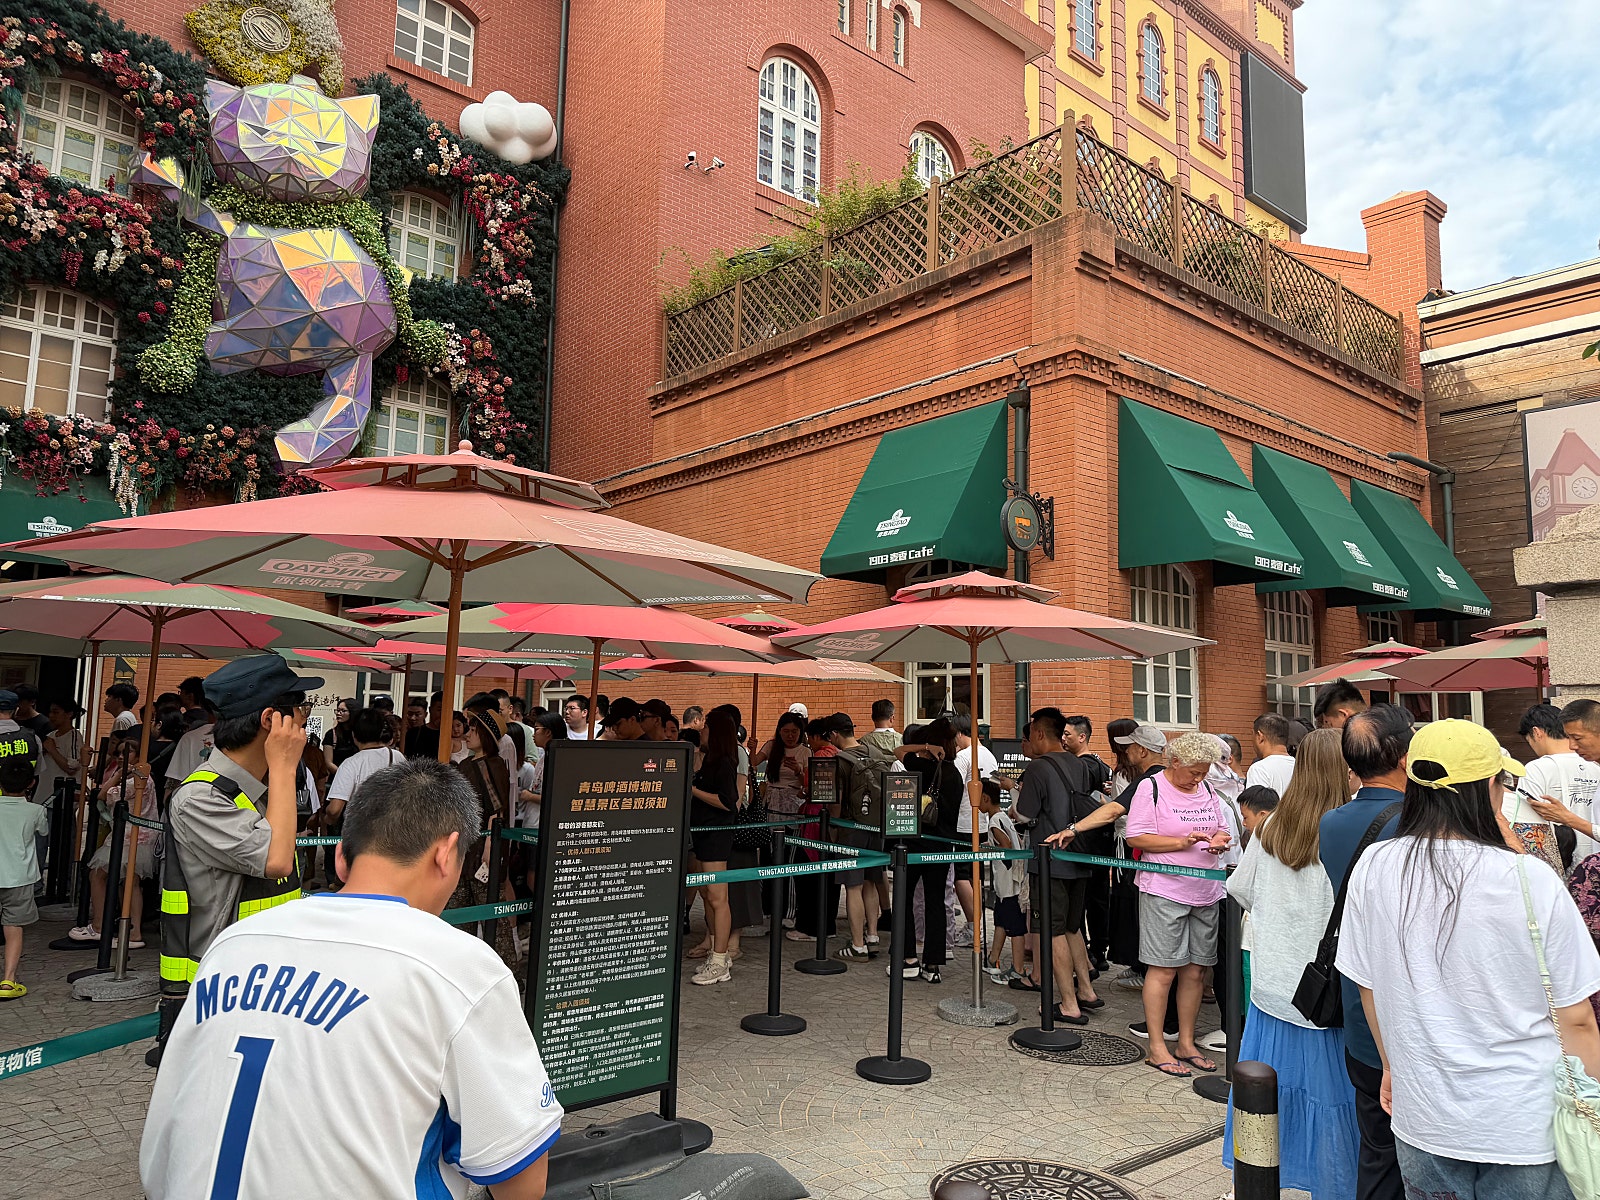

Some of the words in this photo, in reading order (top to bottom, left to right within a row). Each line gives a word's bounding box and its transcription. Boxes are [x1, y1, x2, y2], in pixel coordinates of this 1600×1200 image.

[32, 524, 69, 532] TSINGTAO
[868, 554, 889, 566] 1903
[1254, 556, 1270, 568] 1903
[578, 780, 662, 794] 青岛啤酒博物馆
[570, 796, 668, 812] 智慧景区参观须知
[784, 836, 802, 844] TSINGTAO
[812, 842, 828, 851] MUSEUM
[758, 867, 784, 877] TSINGTAO
[799, 864, 820, 872] MUSEUM
[1091, 856, 1118, 865] TSINGTAO
[1133, 861, 1159, 870] MUSEUM
[1161, 865, 1206, 877] 青岛啤酒博物馆
[494, 902, 528, 915] TSINGTAO
[210, 1035, 275, 1200] 1
